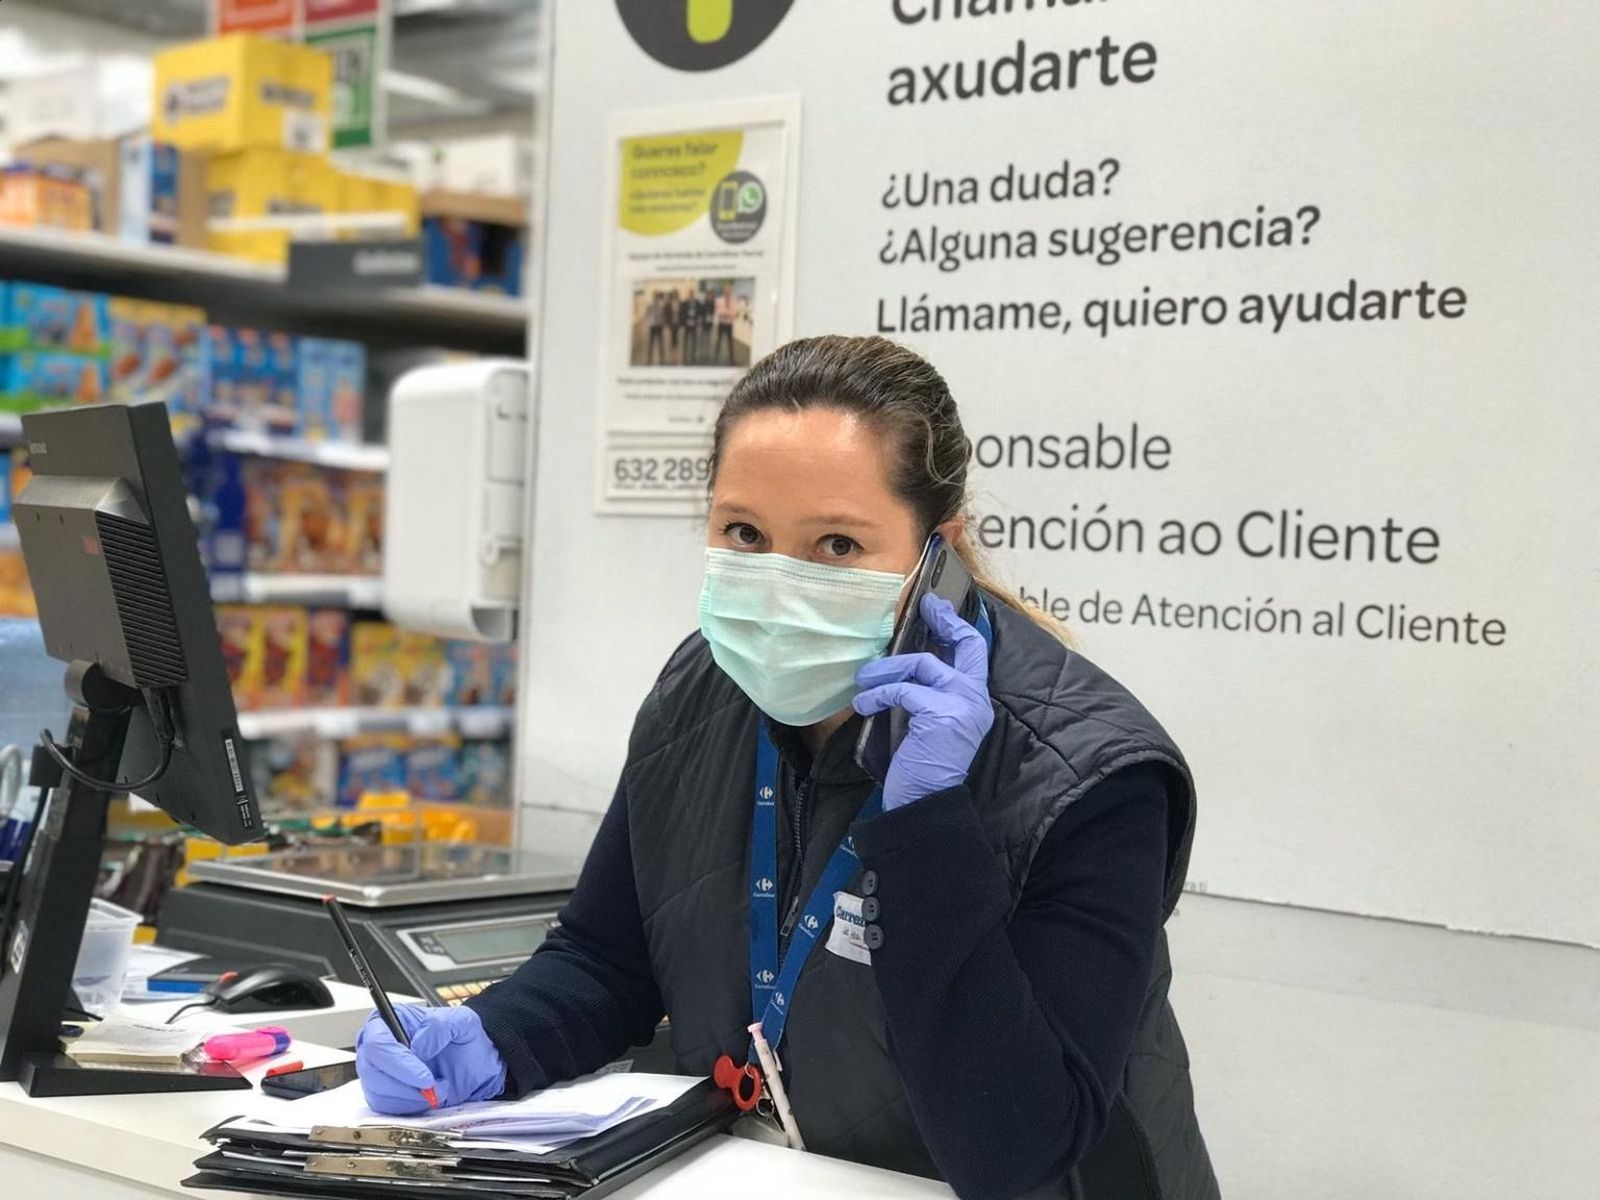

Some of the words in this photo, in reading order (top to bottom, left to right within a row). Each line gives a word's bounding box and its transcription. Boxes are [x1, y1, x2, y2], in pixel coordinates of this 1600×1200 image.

[887, 35, 1158, 106] axudarte
[882, 172, 979, 209] ¿Una
[990, 158, 1120, 204] duda?
[879, 224, 1037, 273] ¿Alguna
[1048, 205, 1321, 266] sugerencia?
[877, 293, 1071, 335] Llámame,
[1083, 286, 1228, 337] quiero
[1239, 278, 1467, 334] ayudarte
[614, 457, 658, 482] 632
[975, 421, 1173, 471] onsable
[978, 503, 1145, 554] ención
[1158, 520, 1222, 556] ao
[1237, 508, 1440, 565] Cliente
[1079, 590, 1123, 625] de
[1131, 596, 1302, 635] Atención
[1312, 601, 1345, 637] al
[1356, 604, 1507, 647] Cliente
